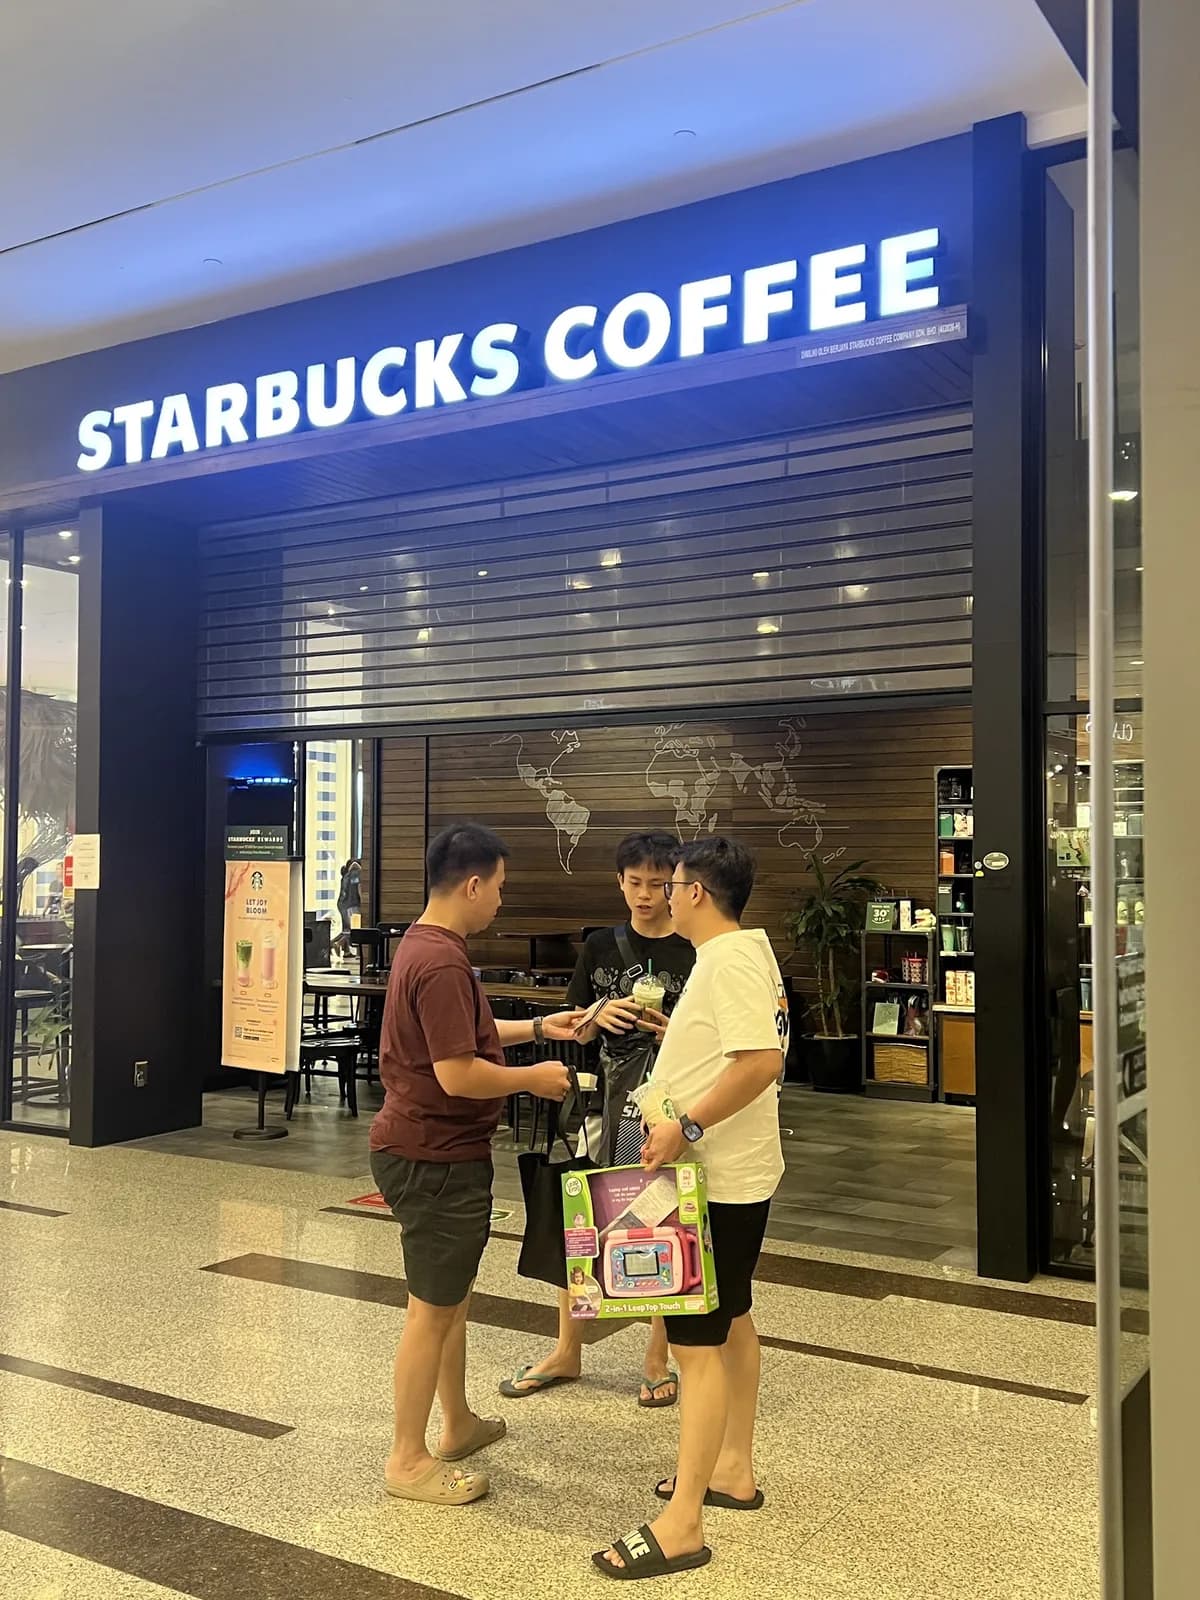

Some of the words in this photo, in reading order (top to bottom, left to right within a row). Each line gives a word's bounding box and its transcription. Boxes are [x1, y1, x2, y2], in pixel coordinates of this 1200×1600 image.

[849, 338, 876, 351] STARBUCKS
[876, 334, 893, 347] COFFEE
[893, 331, 915, 343] COMPANY
[76, 323, 520, 472] STARBUCKS
[543, 227, 941, 381] COFFEE
[246, 898, 256, 906] LET
[605, 1304, 627, 1313] 2-in-1
[659, 1302, 681, 1311] Touch
